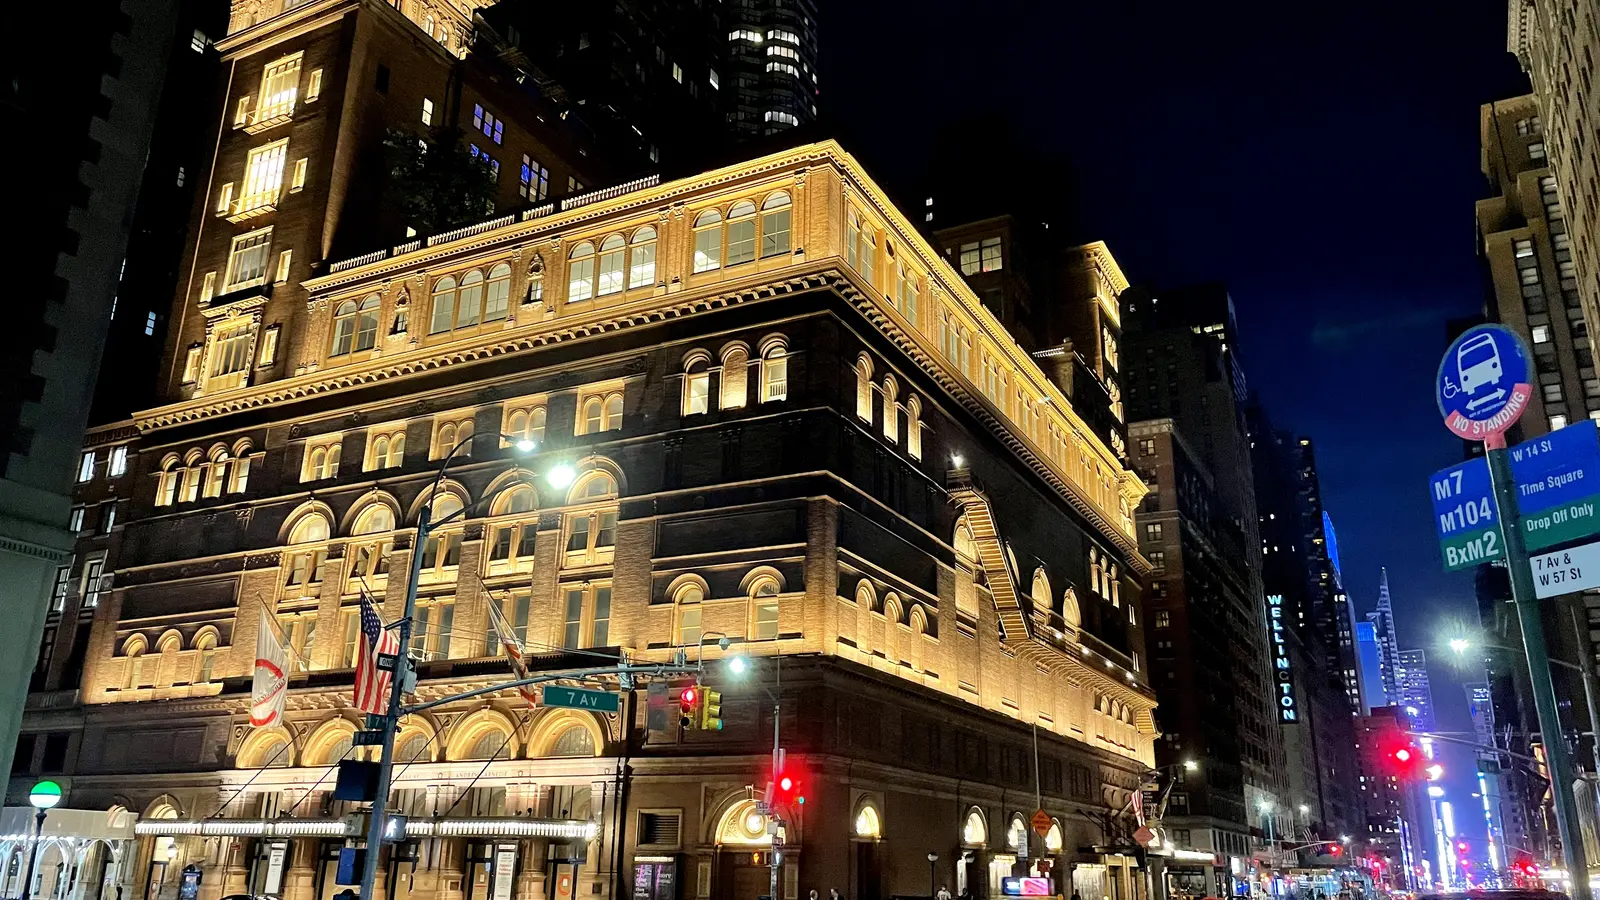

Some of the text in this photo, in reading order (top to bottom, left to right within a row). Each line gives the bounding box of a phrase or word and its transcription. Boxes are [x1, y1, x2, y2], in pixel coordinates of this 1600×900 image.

[1453, 415, 1469, 432] NO
[1472, 391, 1526, 434] STANDING
[1513, 440, 1552, 462] W 14 St
[1434, 470, 1463, 500] M7
[1520, 469, 1584, 496] Time Square
[1440, 497, 1492, 533] M104
[1526, 503, 1594, 533] Drop Off Only
[1446, 530, 1499, 567] BxM2
[1536, 553, 1572, 571] 7 Av &
[1539, 567, 1582, 586] W 57 St
[1267, 594, 1296, 720] WELLINGTON
[567, 692, 597, 706] 7 Av
